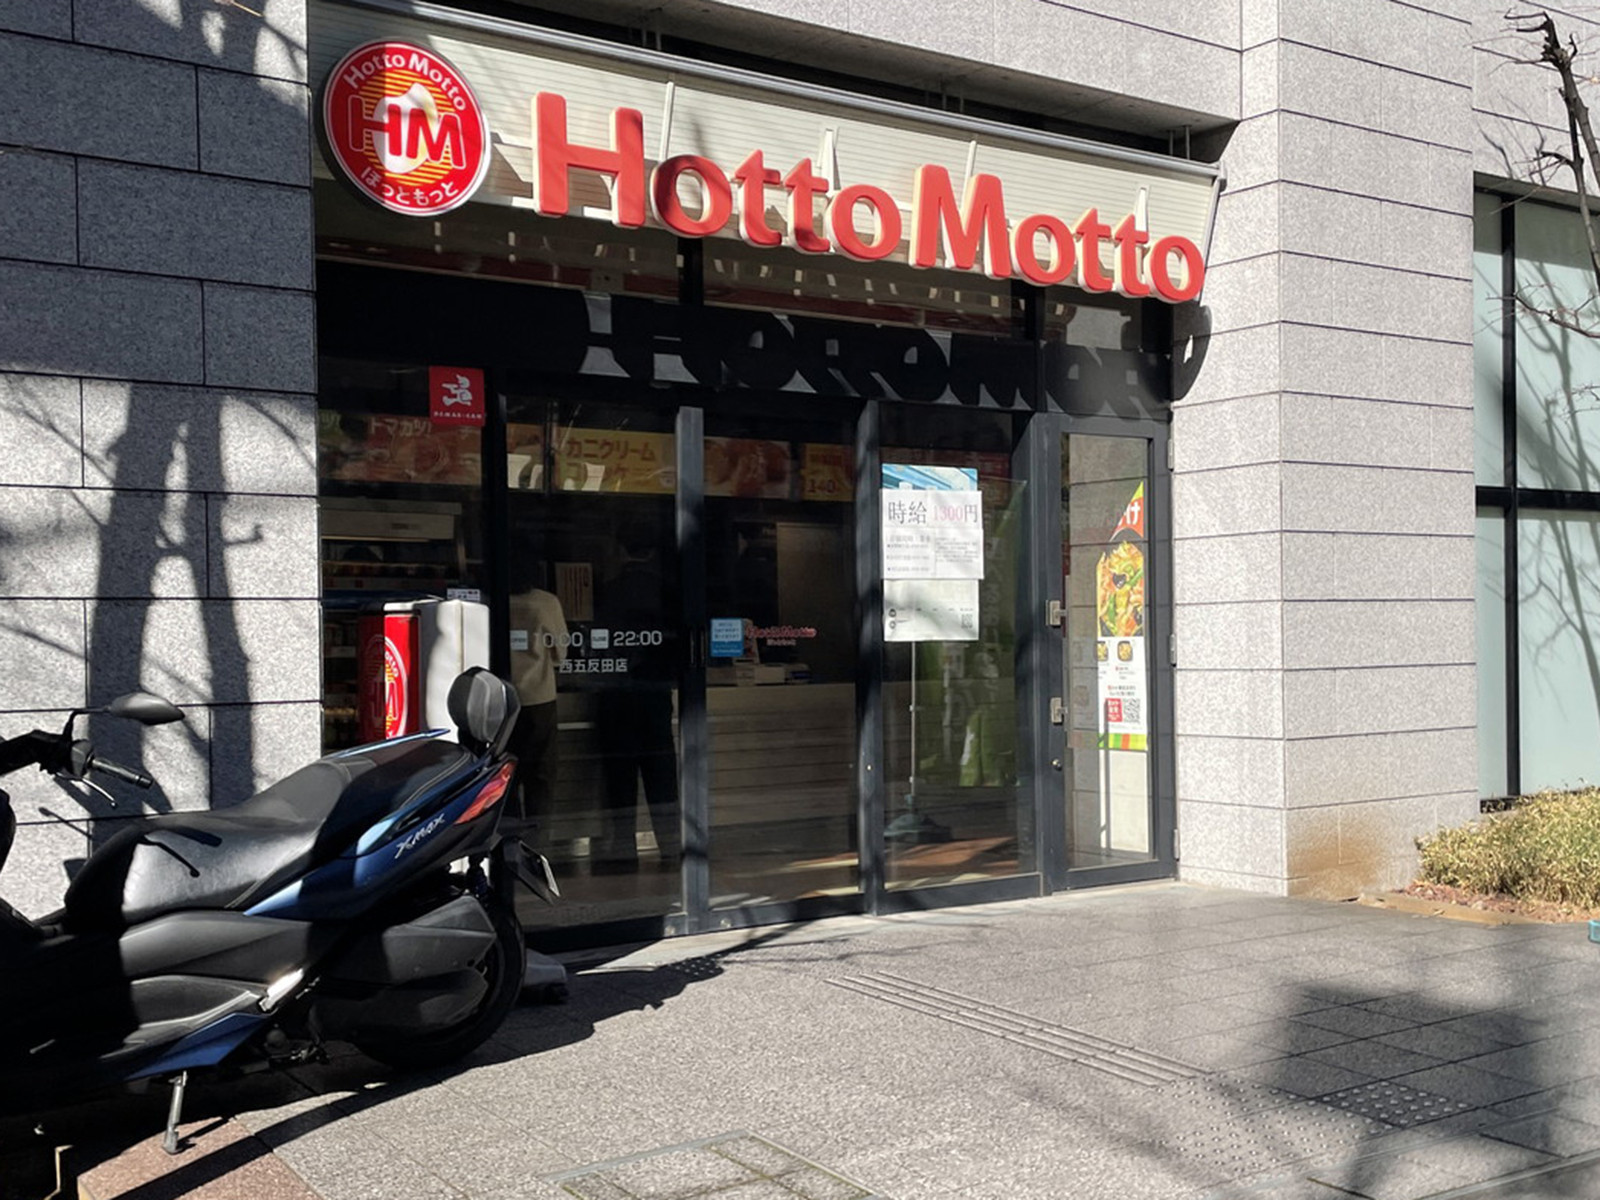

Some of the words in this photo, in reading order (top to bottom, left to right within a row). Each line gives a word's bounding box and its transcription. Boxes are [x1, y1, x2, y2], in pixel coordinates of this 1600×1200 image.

[360, 165, 459, 206] ほっともっと
[566, 436, 656, 461] カニクリーム
[888, 499, 928, 525] 時給
[932, 503, 979, 524] 1300円
[613, 629, 663, 647] 22:00
[558, 658, 629, 674] 西五反田店
[394, 813, 446, 859] XMAX
